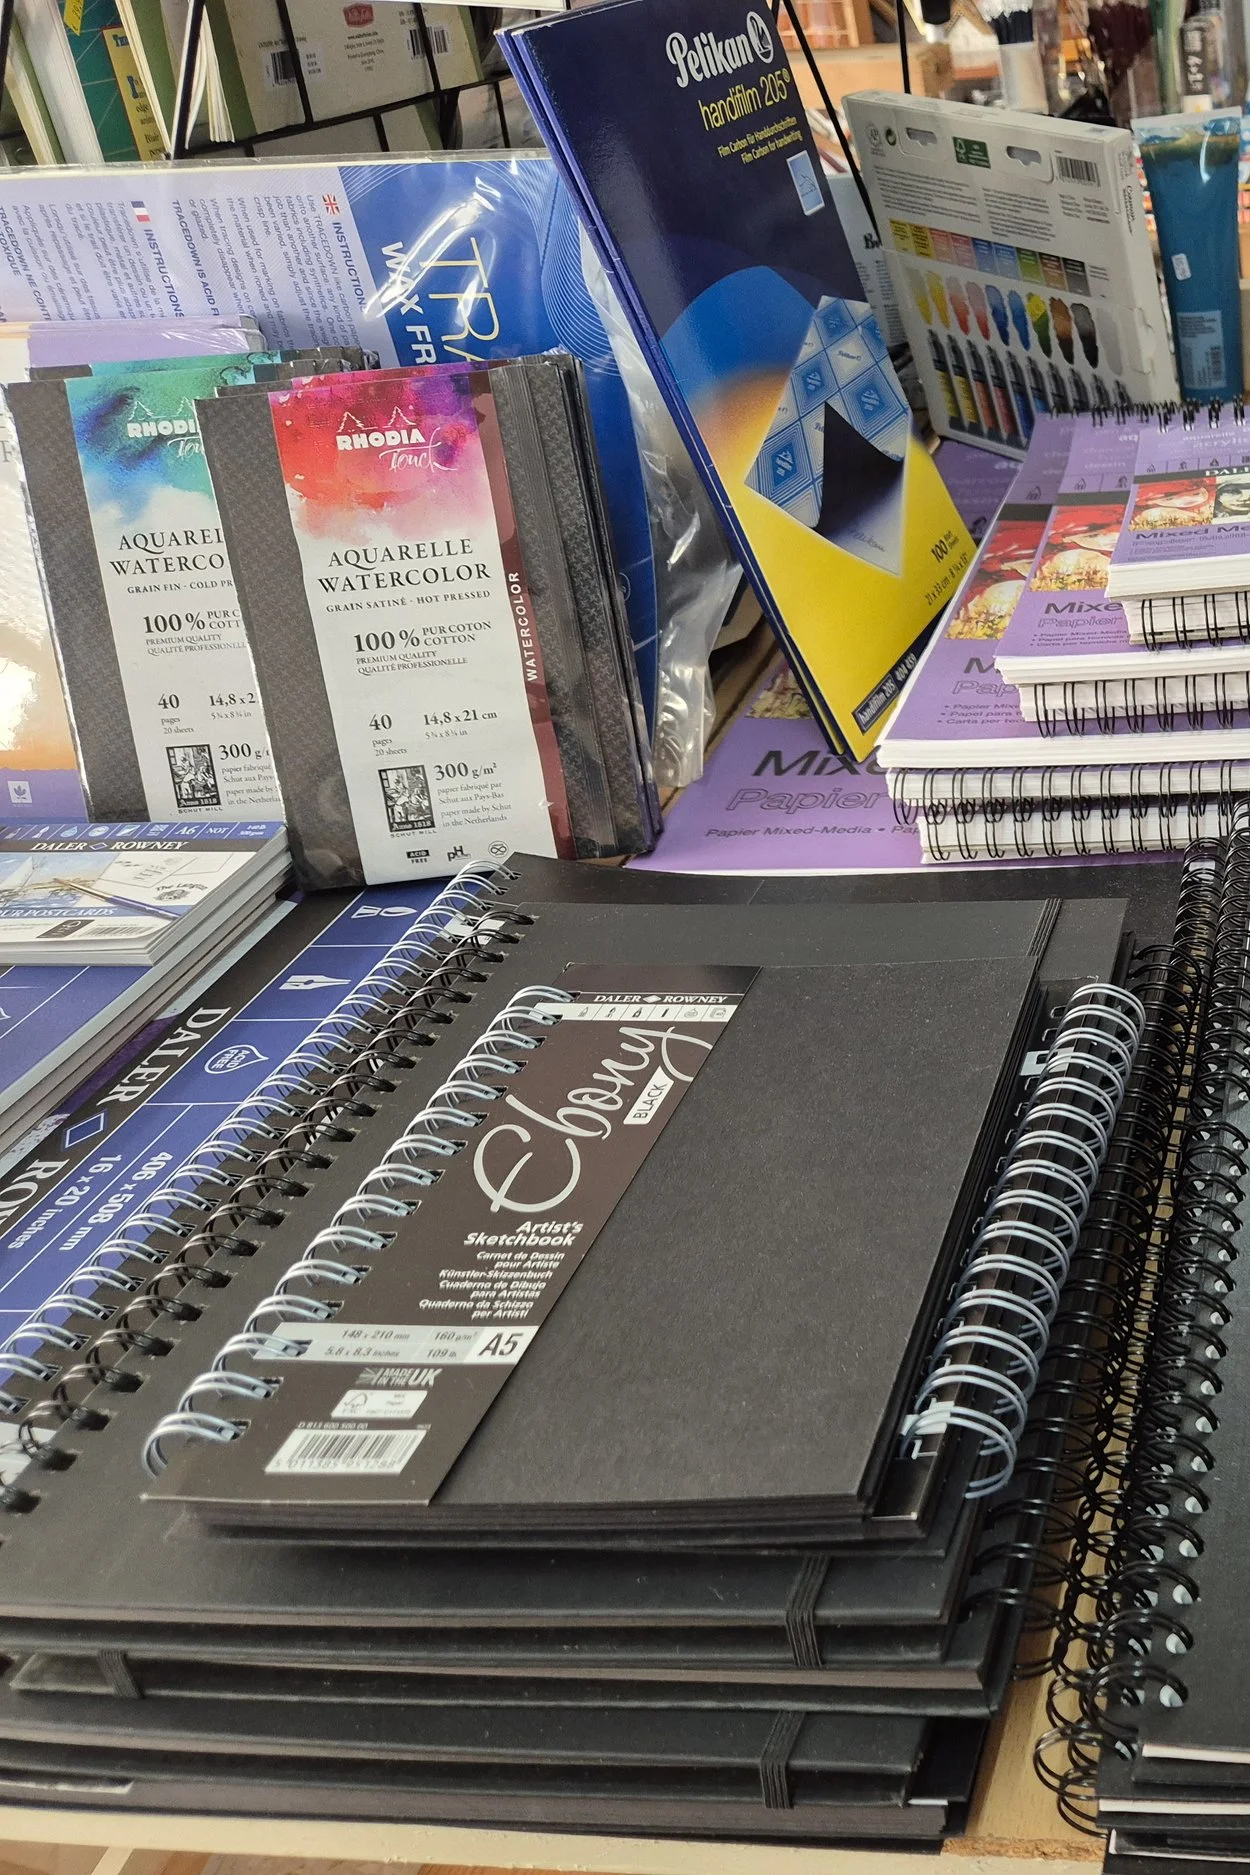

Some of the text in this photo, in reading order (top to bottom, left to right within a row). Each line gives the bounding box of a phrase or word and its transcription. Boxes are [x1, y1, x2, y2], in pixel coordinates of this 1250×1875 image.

[666, 32, 754, 88] Pelikan
[698, 83, 762, 131] handifilm
[303, 217, 318, 251] another
[171, 199, 216, 306] TRACEDOWN ACID
[296, 227, 313, 266] including
[314, 215, 338, 275] TRACEDOWN
[381, 242, 423, 315] WAX
[335, 428, 426, 451] RHODIA
[1135, 528, 1209, 541] Mixed
[328, 538, 473, 571] AQUARELLE
[109, 553, 225, 576] WATERCO
[127, 581, 218, 594] GRAIN FIN COLD
[317, 563, 491, 594] WATERCOLOR
[326, 590, 491, 613] GRAIN SATINÉ HOT PRESSED
[143, 612, 205, 633] 100 %
[207, 610, 229, 619] PUR
[422, 621, 492, 636] PUR COTON
[508, 572, 538, 681] WATERCOLOR
[145, 633, 222, 645] PREMIUM QUALITY
[353, 628, 421, 653] 100 %
[423, 634, 476, 647] COTTON
[356, 651, 437, 665] PREMIUM QUALITY
[358, 657, 468, 676] QUALITÉ PROFESSIONELLE
[158, 693, 180, 710] 40
[208, 692, 237, 708] 14,8
[369, 714, 393, 731] 40
[423, 709, 498, 726] 14,8 21 cm
[218, 743, 252, 760] 300
[372, 738, 393, 748] pages
[433, 762, 497, 781] 300 g/m²
[725, 787, 887, 815] Papier
[175, 826, 199, 836] A6
[205, 827, 229, 835] NOT
[705, 826, 872, 838] Papier Mixed-Media
[31, 841, 189, 851] DALER ROWNEY
[27, 907, 117, 917] POSTCARDS
[593, 994, 728, 1005] DALER ROWNEY
[96, 1007, 232, 1106] DALER
[211, 1050, 236, 1070] FREE
[226, 1050, 250, 1069] ACID
[633, 1083, 668, 1120] BLACK
[473, 1026, 713, 1213] Ebony
[7, 1154, 123, 1249] 16 20 inches
[59, 1152, 174, 1251] 406 508 mm
[516, 1221, 584, 1234] Artist's
[463, 1232, 576, 1247] Sketchbook
[476, 1251, 565, 1261] Carnet Dessin
[438, 1270, 553, 1279] Künstler-Skizzenbuch
[470, 1290, 541, 1300] para Artistas
[341, 1330, 455, 1341] 148 210 160
[478, 1333, 524, 1357] A5
[426, 1349, 447, 1358] 109
[384, 1368, 414, 1376] MADE
[408, 1368, 443, 1387] UK
